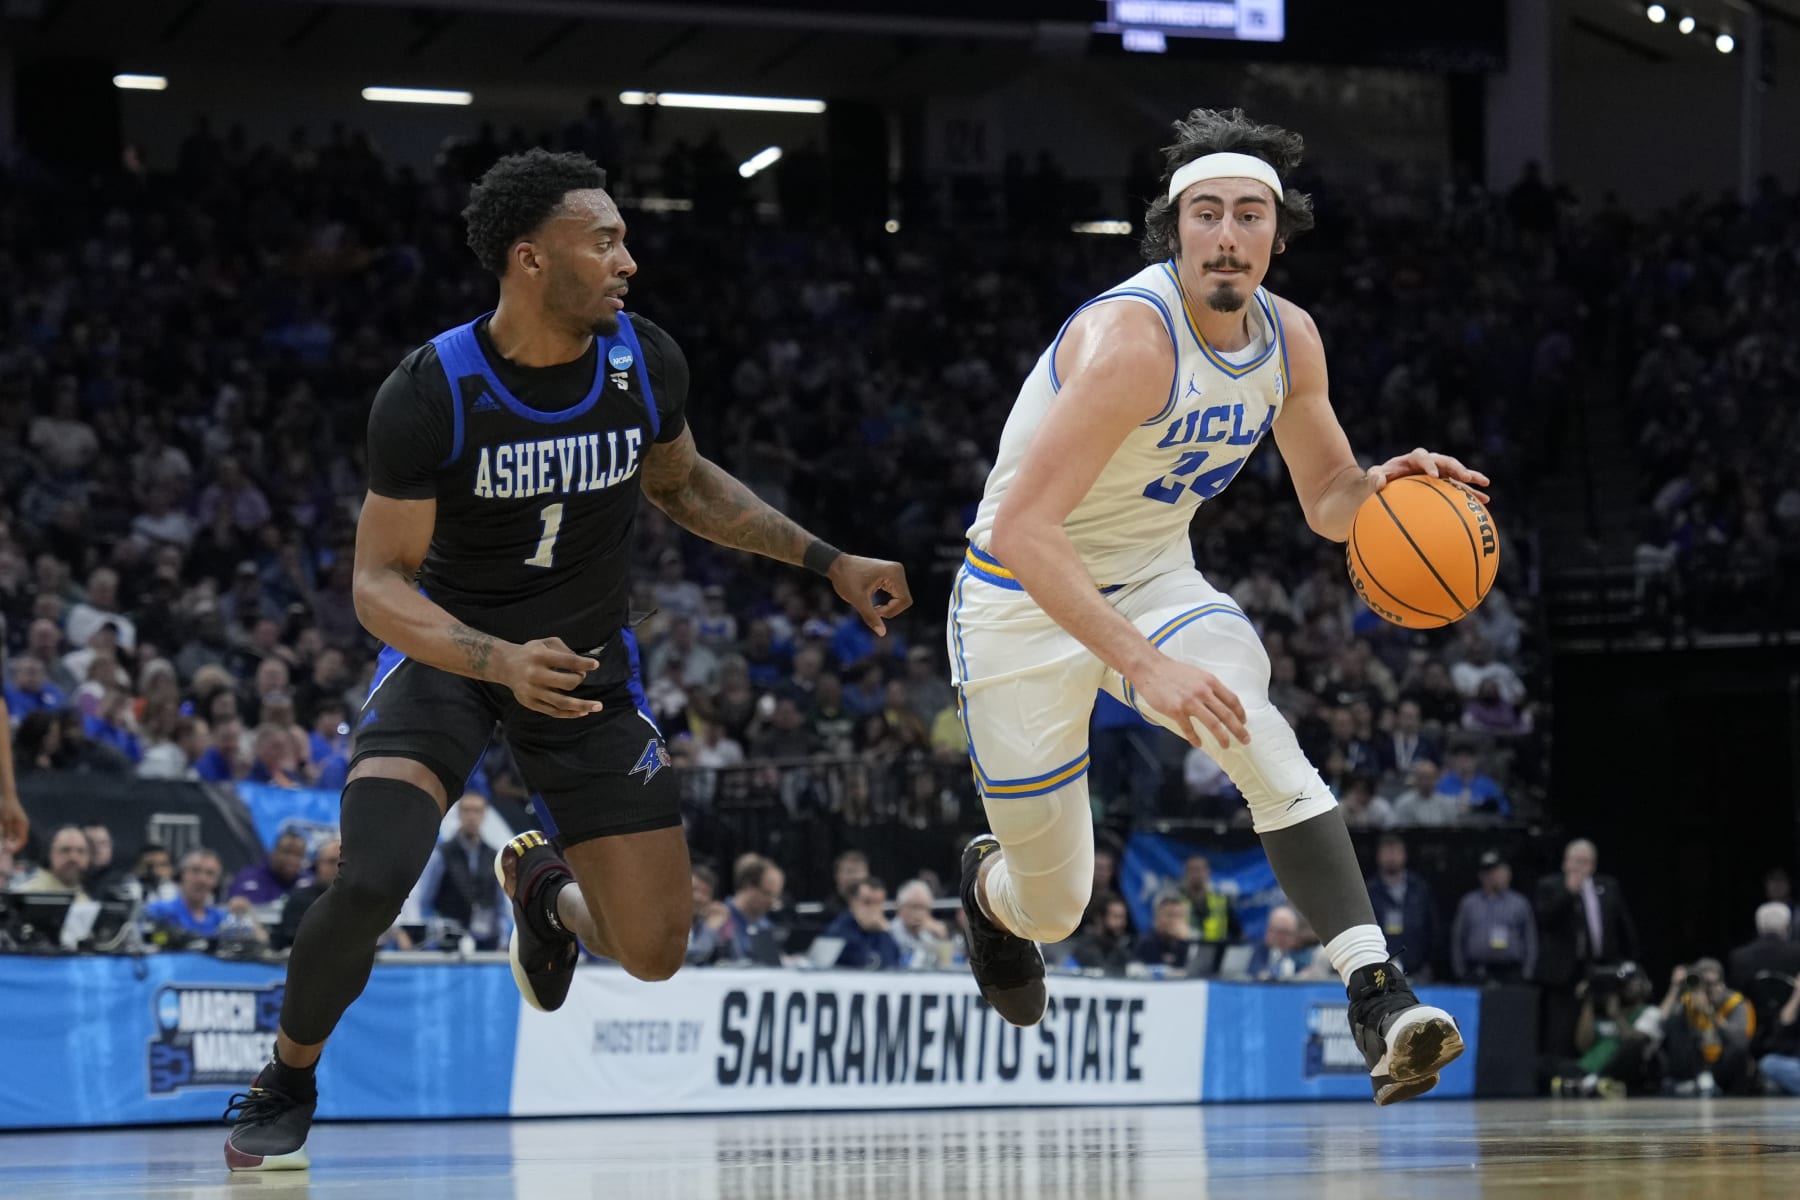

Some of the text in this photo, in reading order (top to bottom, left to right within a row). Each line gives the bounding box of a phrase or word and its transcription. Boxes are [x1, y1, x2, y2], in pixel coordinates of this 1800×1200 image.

[612, 354, 633, 367] NCAA
[474, 427, 642, 499] ASHEVILLE
[1142, 450, 1247, 505] 24
[524, 502, 564, 568] 1
[193, 1032, 277, 1073] MADNE
[592, 1019, 703, 1054] HOSTED BY
[717, 990, 1144, 1085] SACRAMENTO STATE
